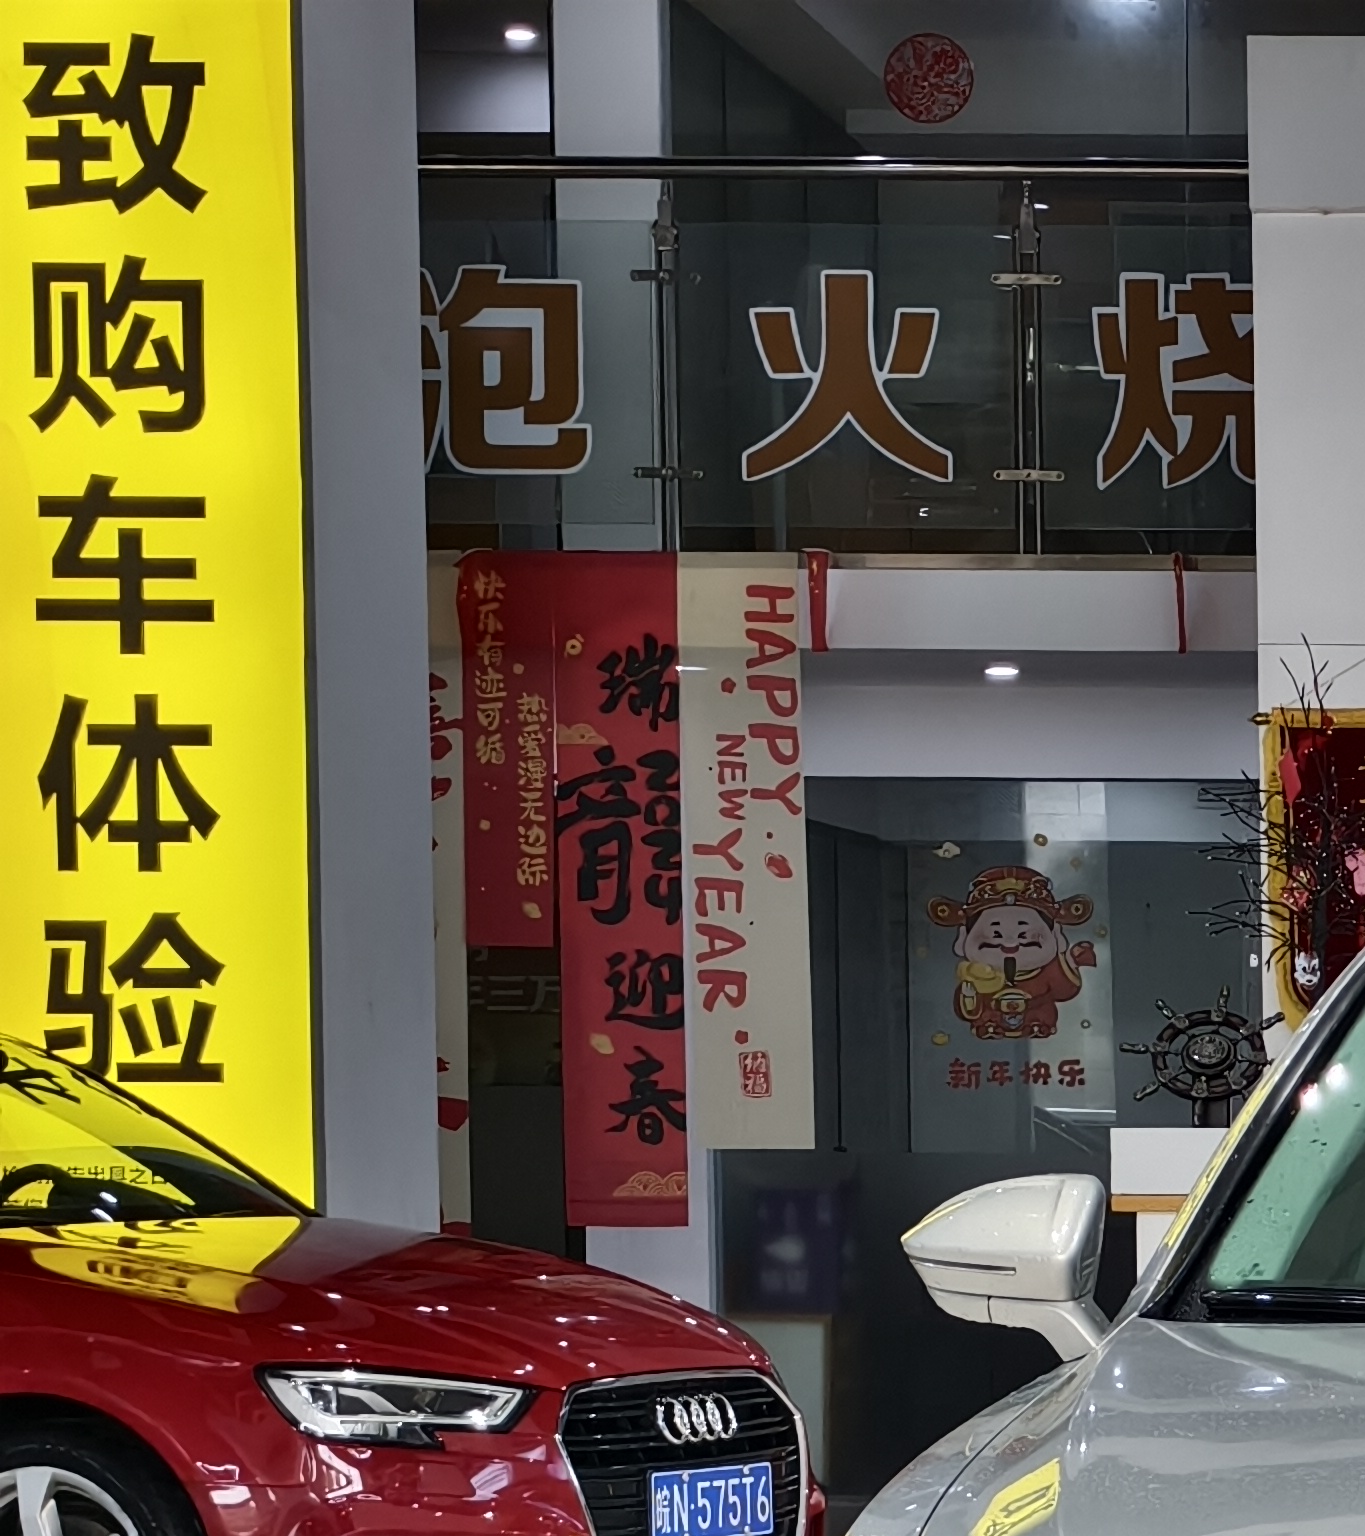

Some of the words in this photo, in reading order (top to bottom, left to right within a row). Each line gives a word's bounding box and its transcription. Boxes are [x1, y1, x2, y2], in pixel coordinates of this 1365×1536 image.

[22, 32, 226, 1084] 致购车体验
[474, 570, 507, 765] 快乐有迹可循
[744, 584, 802, 816] HAPPY
[516, 692, 549, 887] 热爱漫无边际
[715, 733, 748, 821] NEW
[692, 827, 747, 1013] YEAR
[946, 1057, 1086, 1090] 新年快乐
